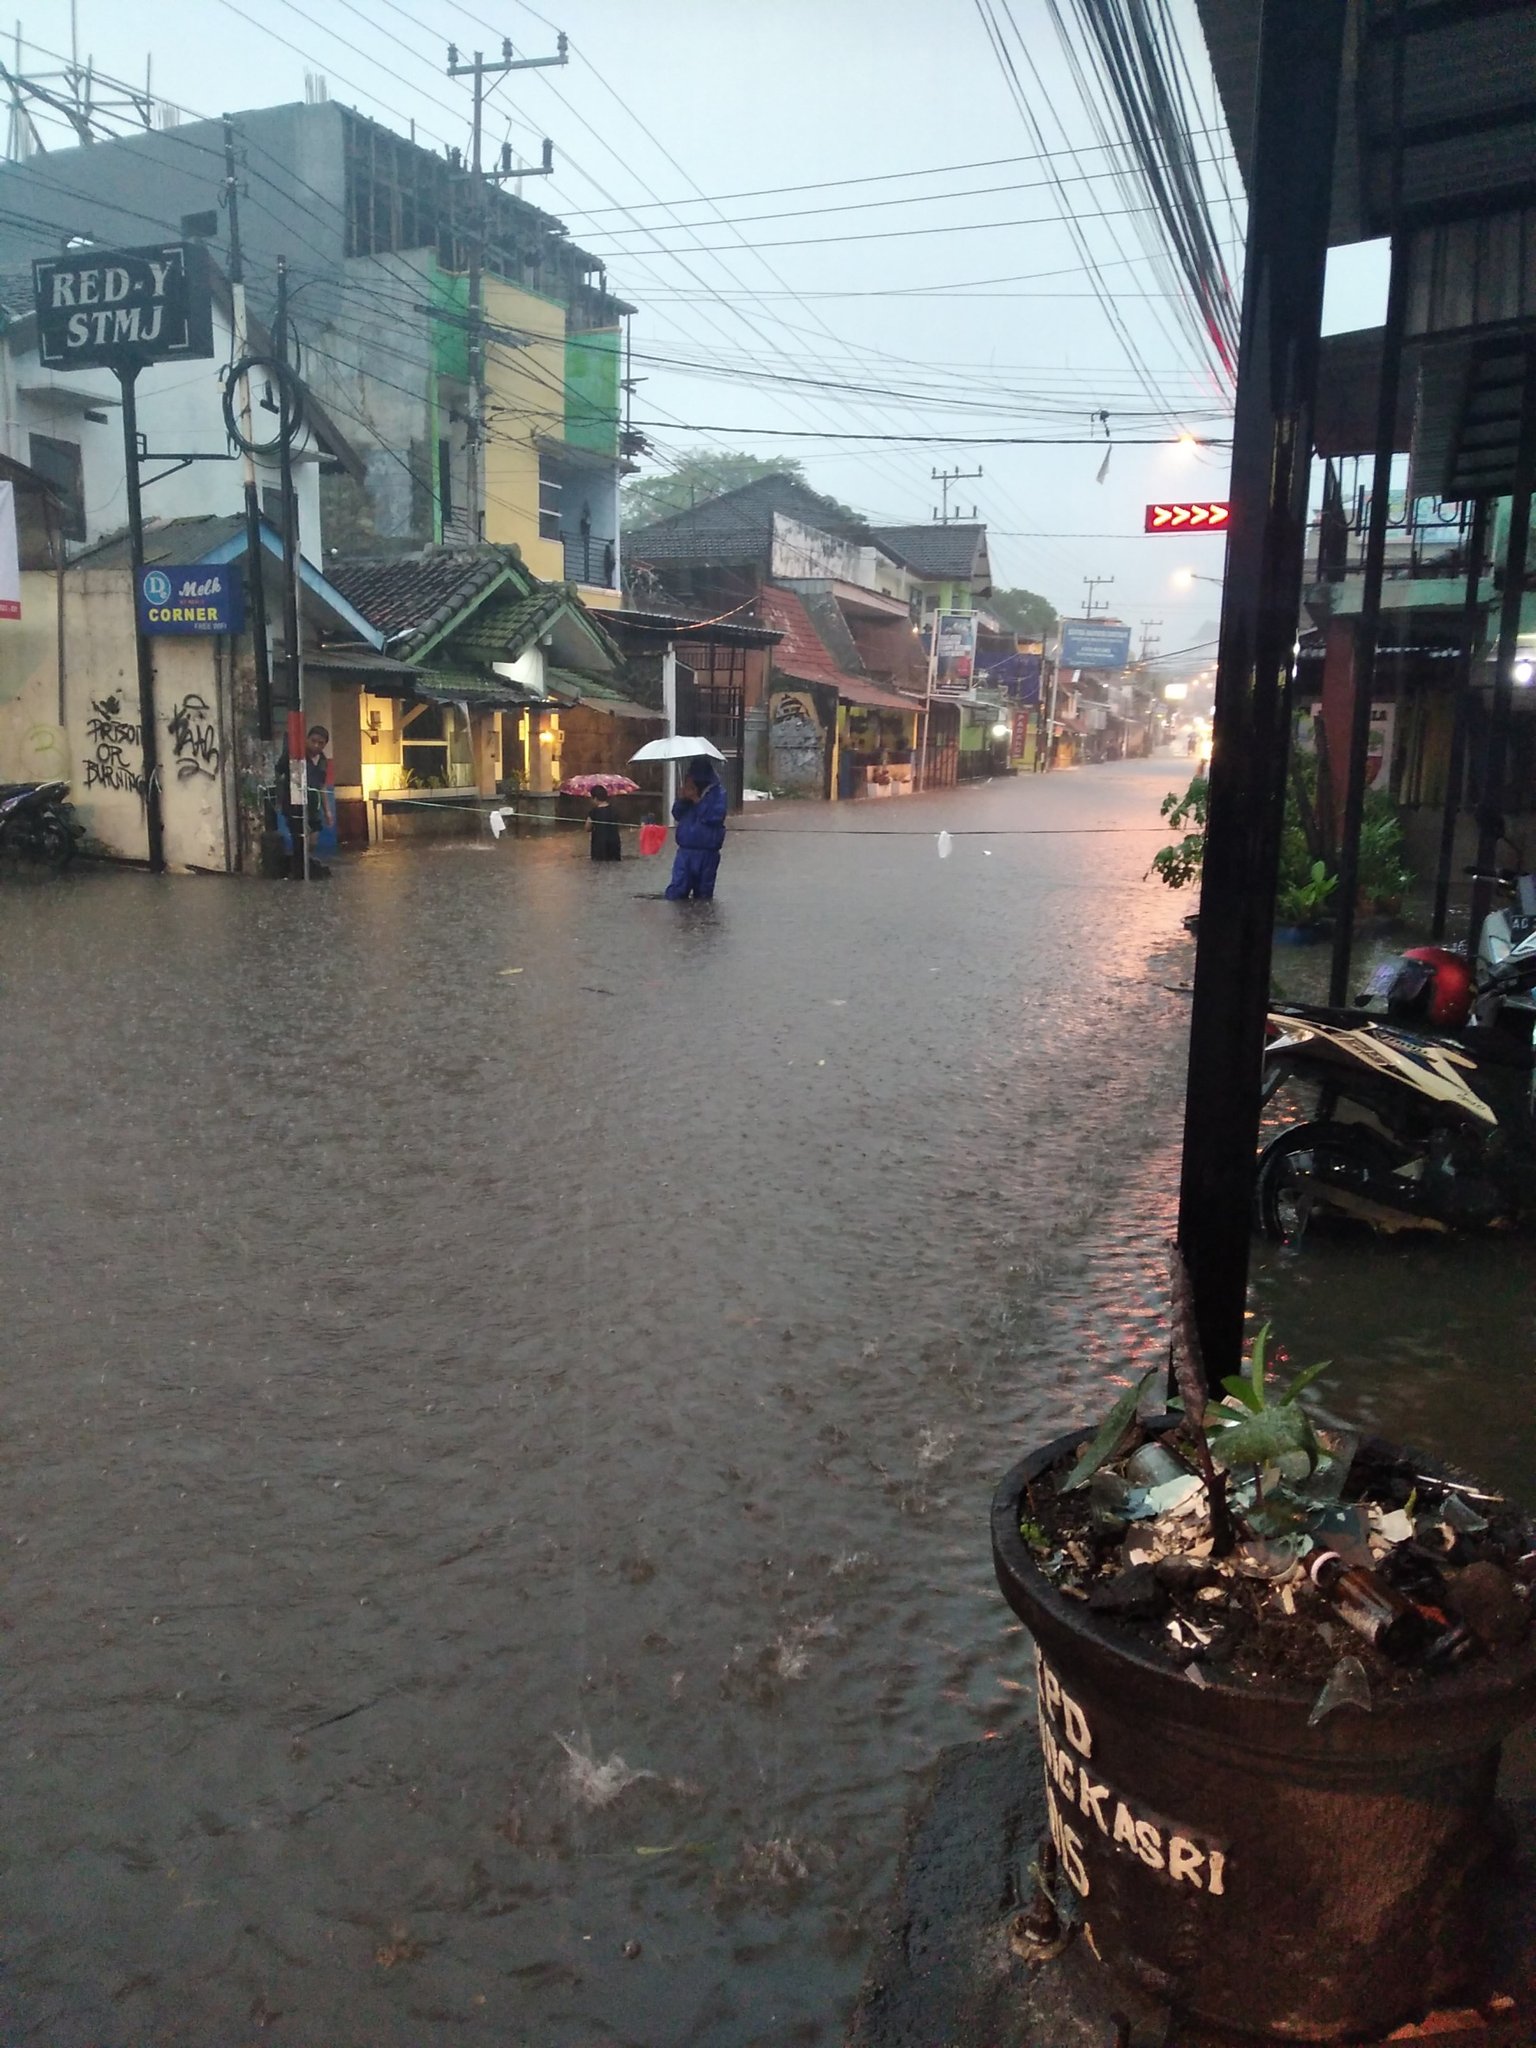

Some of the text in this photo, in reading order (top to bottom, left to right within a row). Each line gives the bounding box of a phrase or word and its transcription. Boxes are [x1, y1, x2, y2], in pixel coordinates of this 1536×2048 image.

[51, 260, 173, 308] RED-Y
[66, 305, 164, 348] STMJ
[148, 607, 218, 622] CORNER
[97, 743, 130, 767] OR
